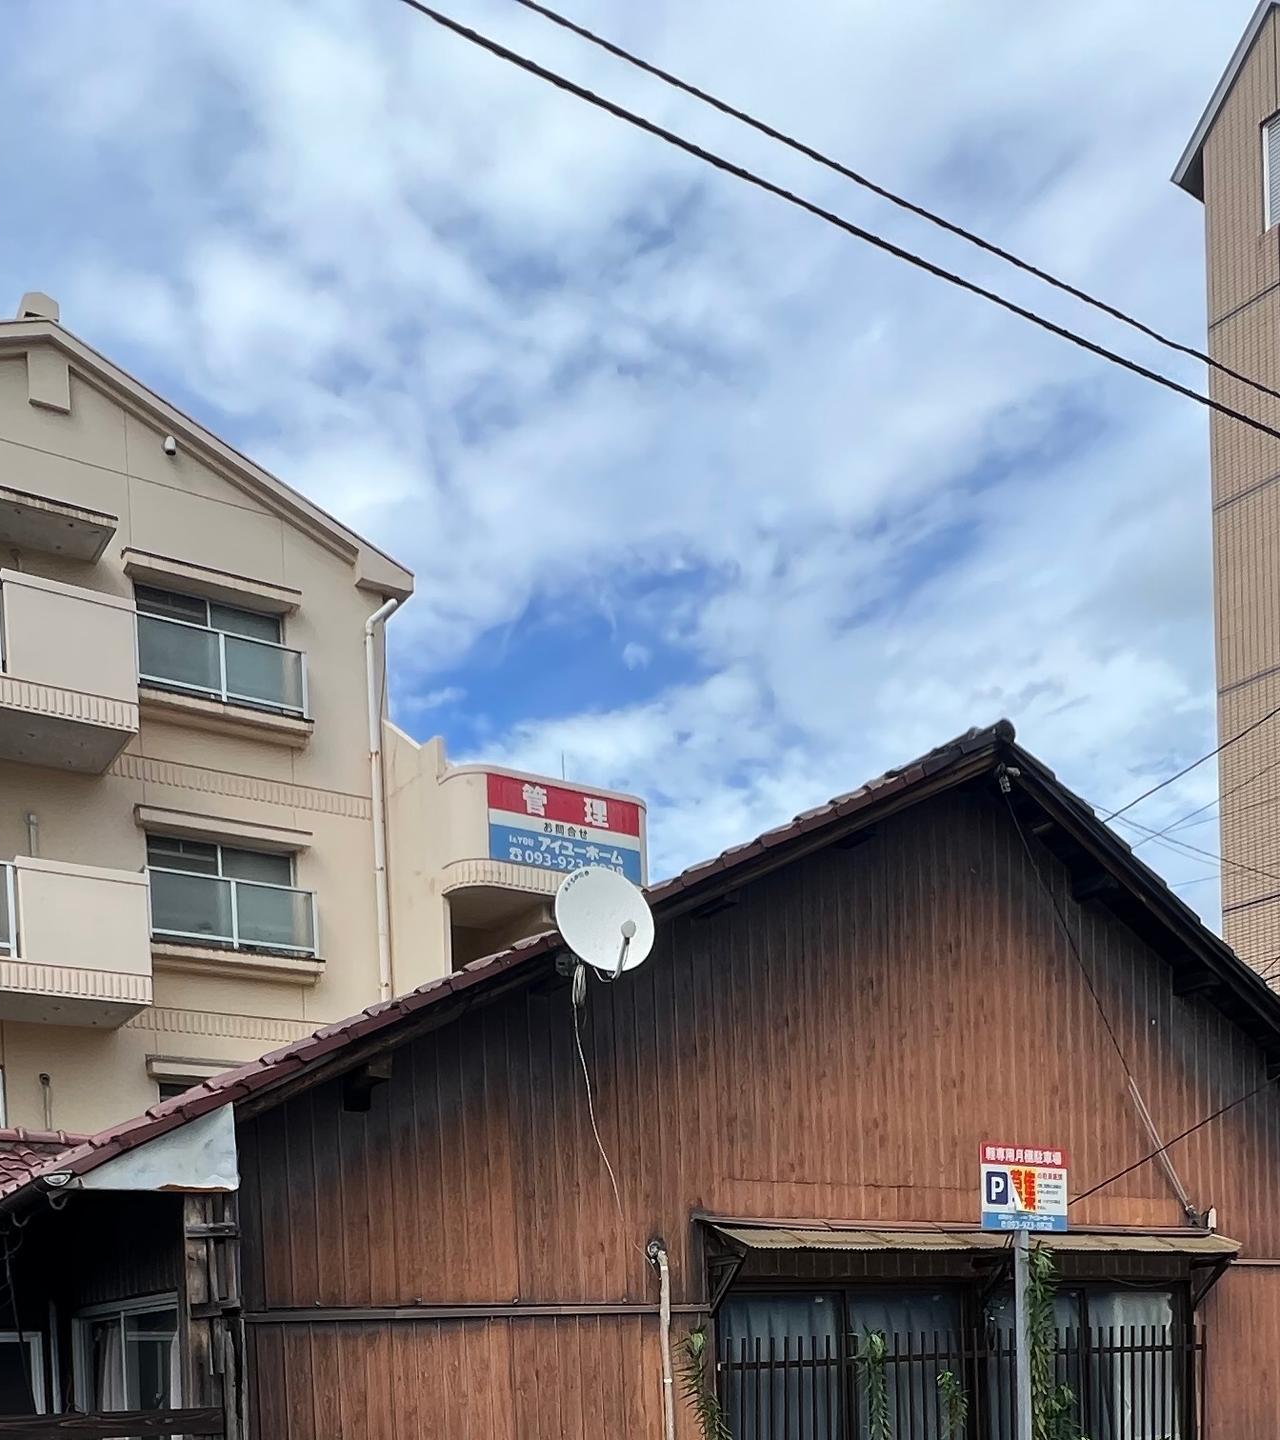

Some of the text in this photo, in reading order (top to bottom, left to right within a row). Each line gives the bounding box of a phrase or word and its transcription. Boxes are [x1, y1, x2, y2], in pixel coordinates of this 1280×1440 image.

[522, 783, 609, 829] 管理
[543, 822, 588, 841] お問合せ
[537, 836, 624, 865] アイユーホーム
[990, 1176, 1005, 1201] P
